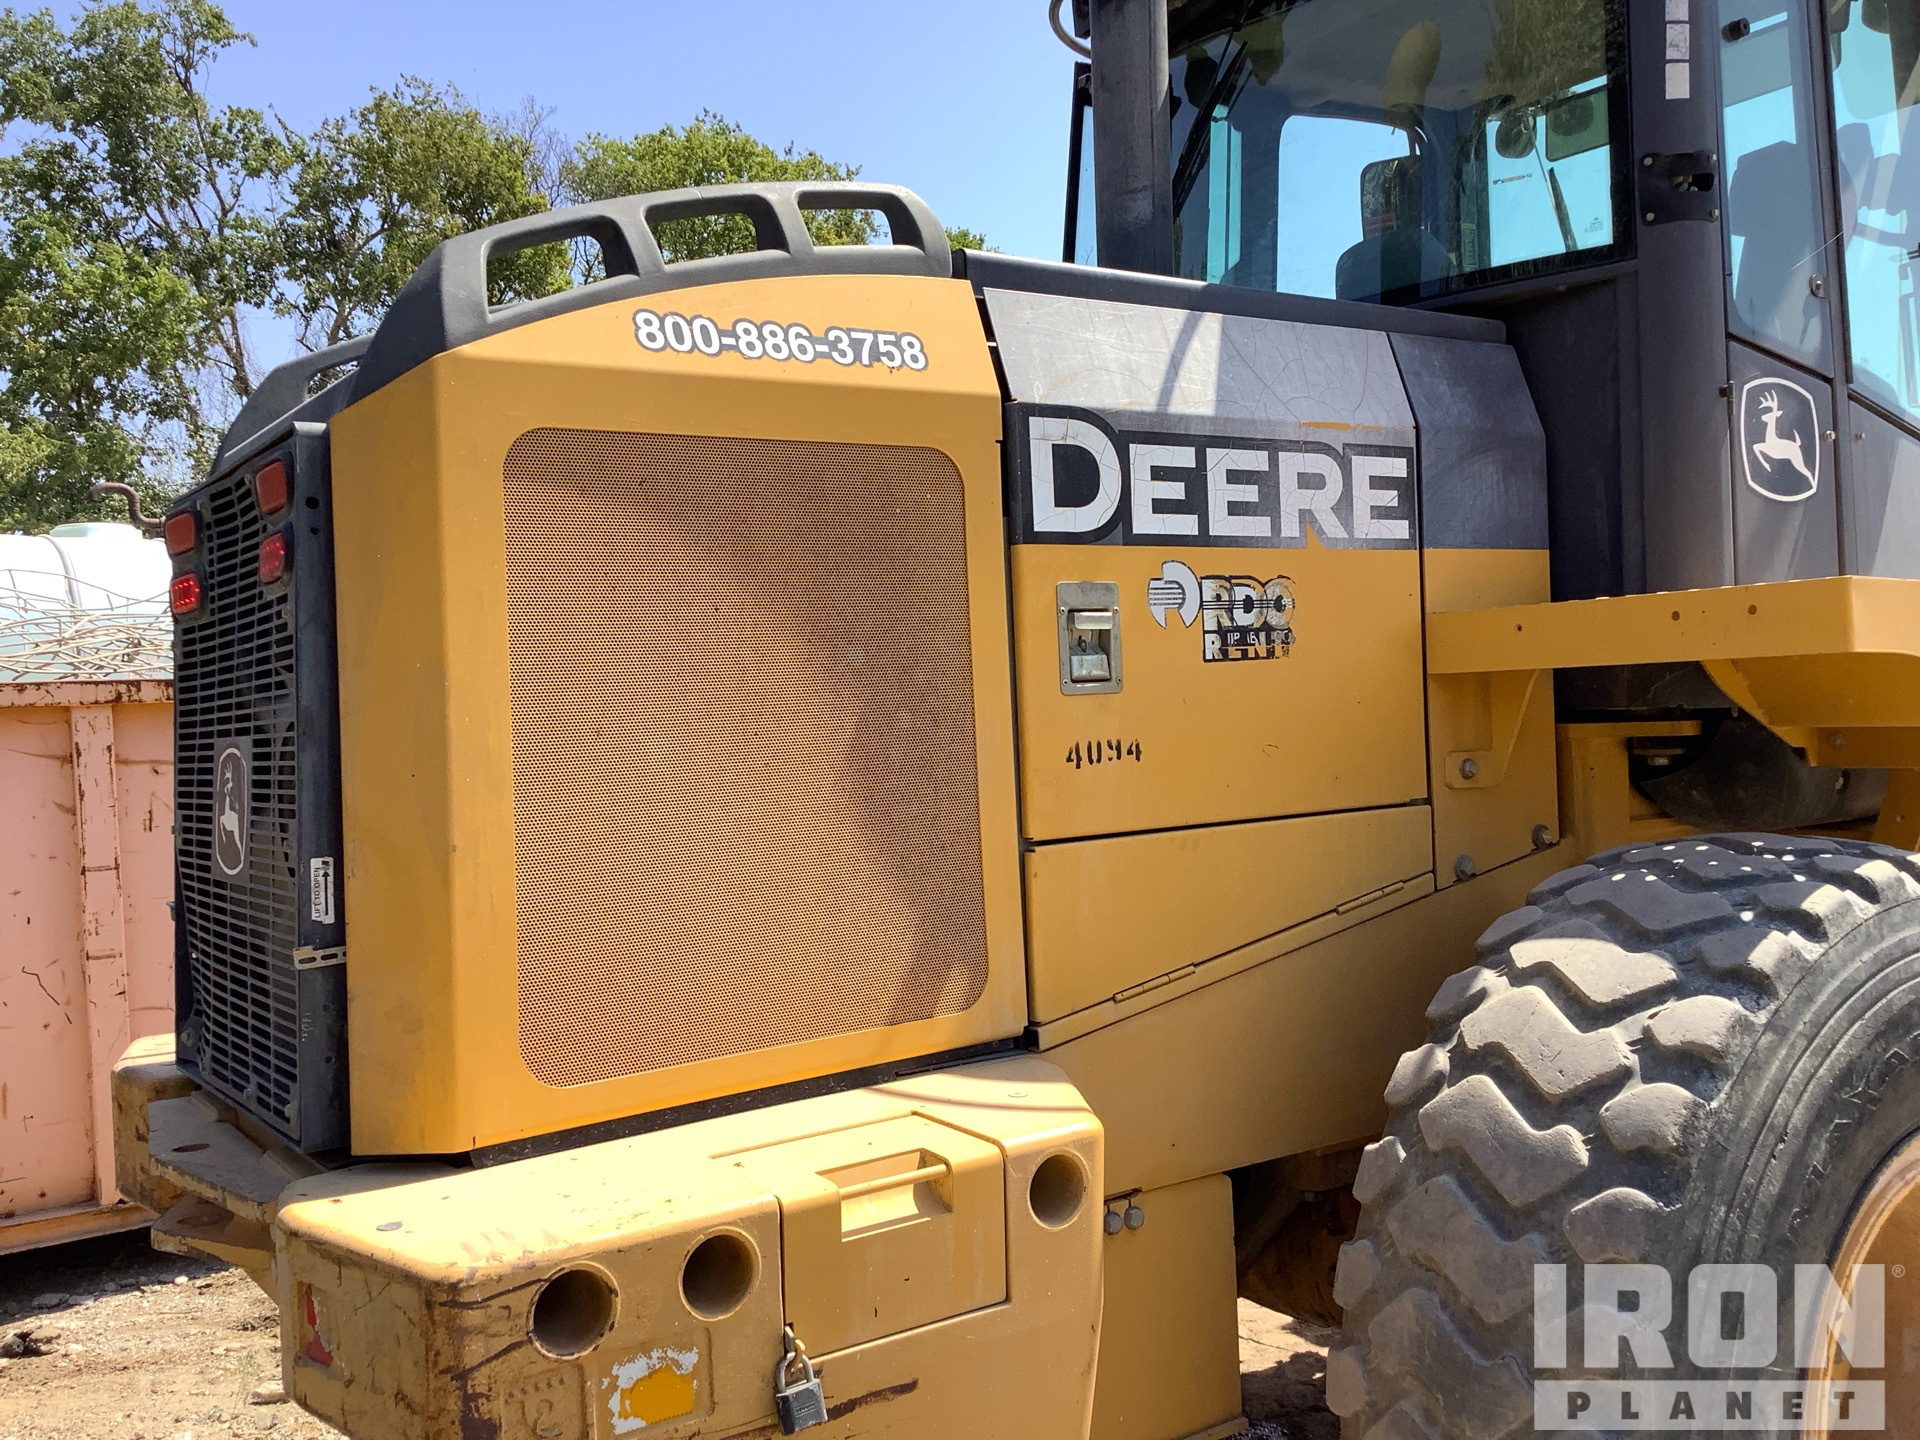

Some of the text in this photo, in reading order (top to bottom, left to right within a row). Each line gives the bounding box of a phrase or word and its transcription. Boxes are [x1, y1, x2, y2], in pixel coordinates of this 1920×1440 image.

[634, 310, 927, 370] 800-886-3758
[1028, 416, 1410, 540] DEERE
[314, 891, 320, 900] TO
